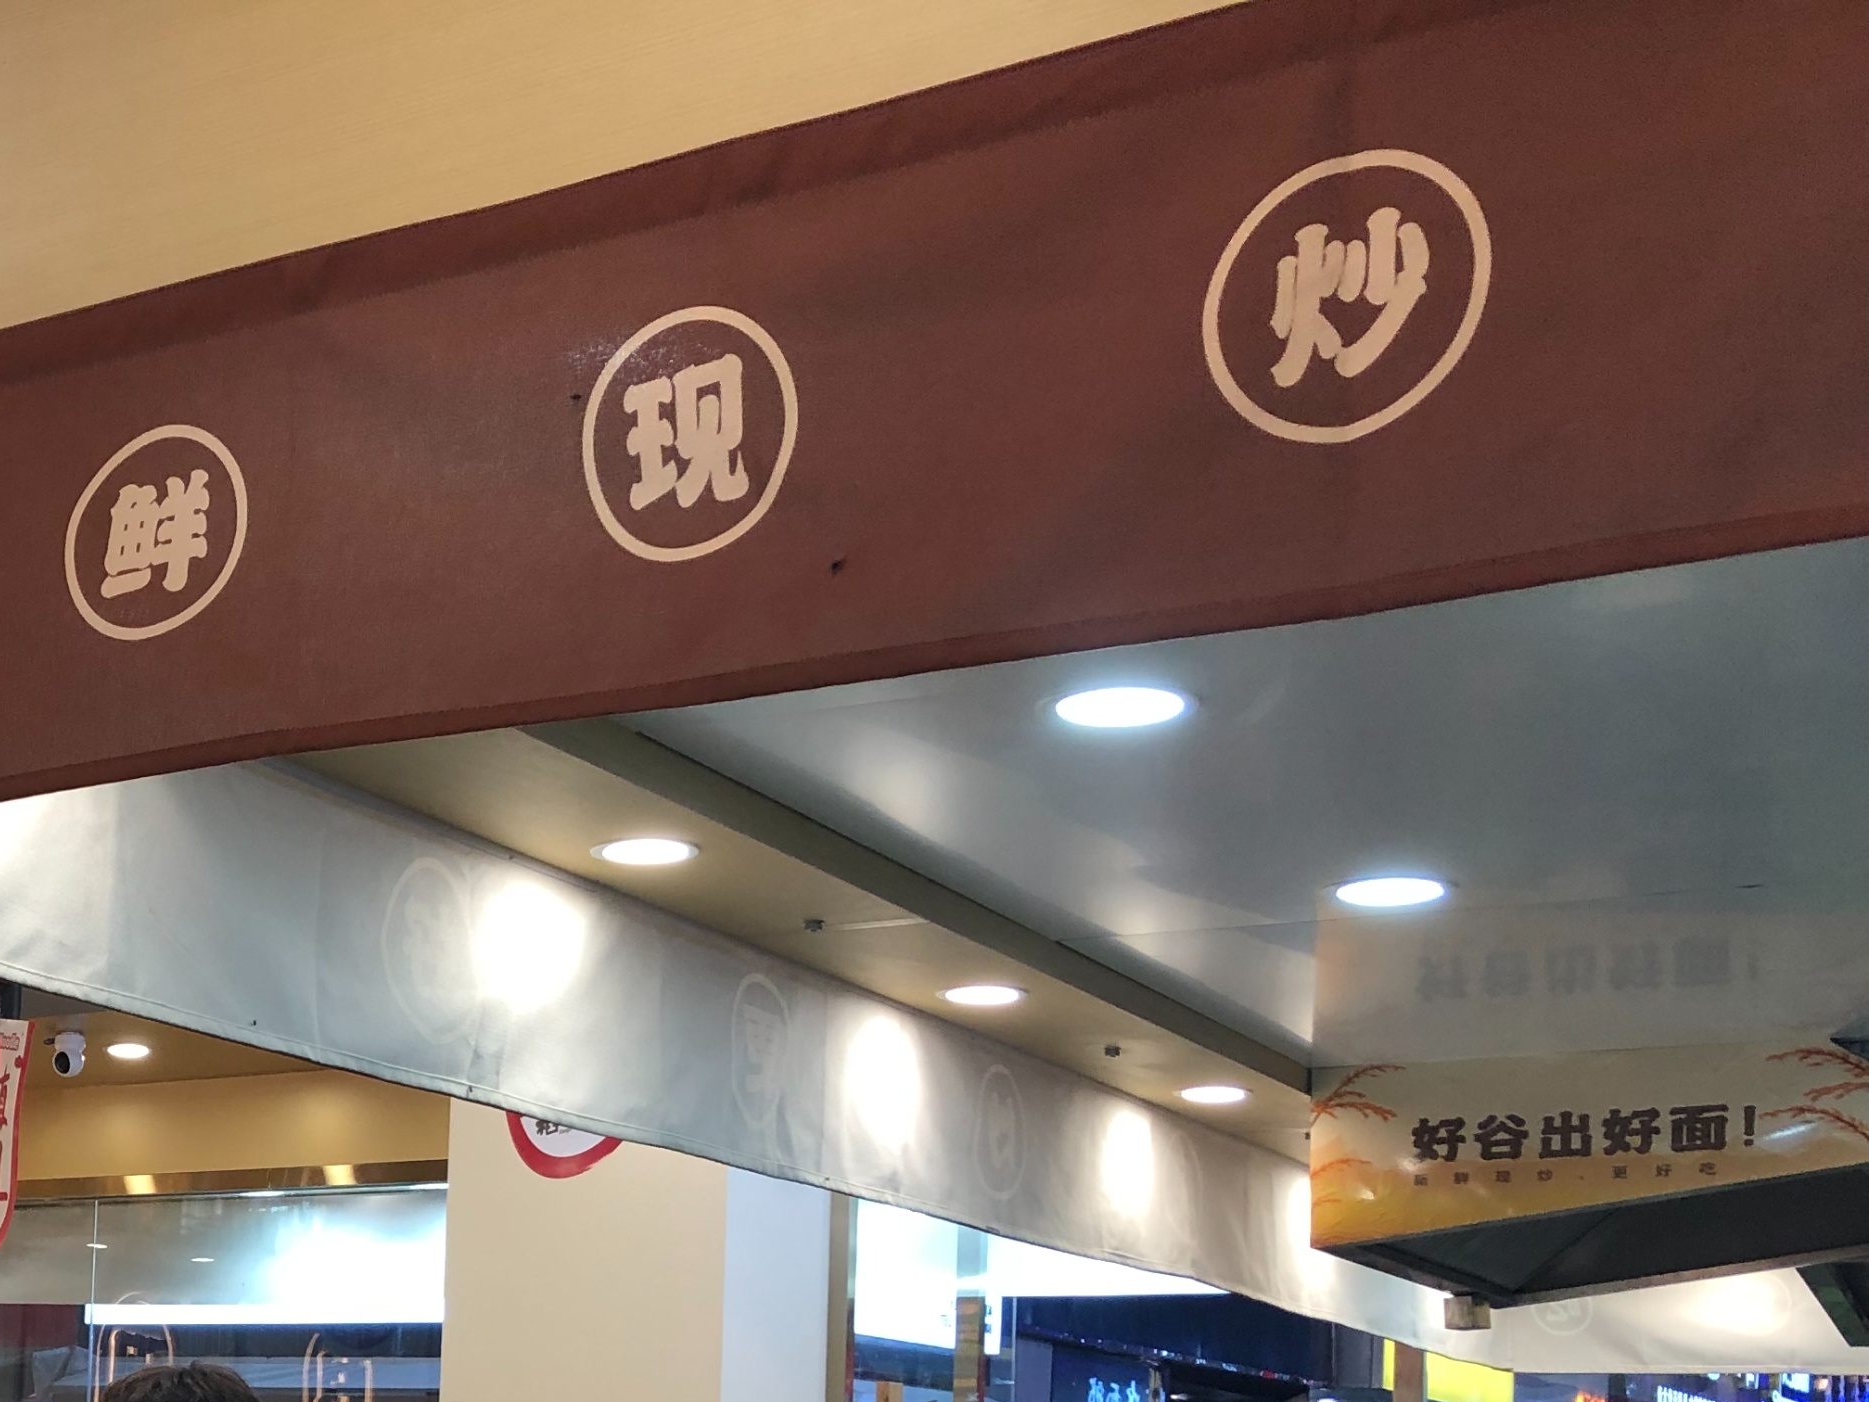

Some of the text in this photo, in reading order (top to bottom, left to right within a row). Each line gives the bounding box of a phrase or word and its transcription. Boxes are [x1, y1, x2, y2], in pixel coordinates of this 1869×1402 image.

[101, 469, 210, 599] 鲜
[622, 353, 749, 510] 现
[1270, 207, 1430, 388] 炒
